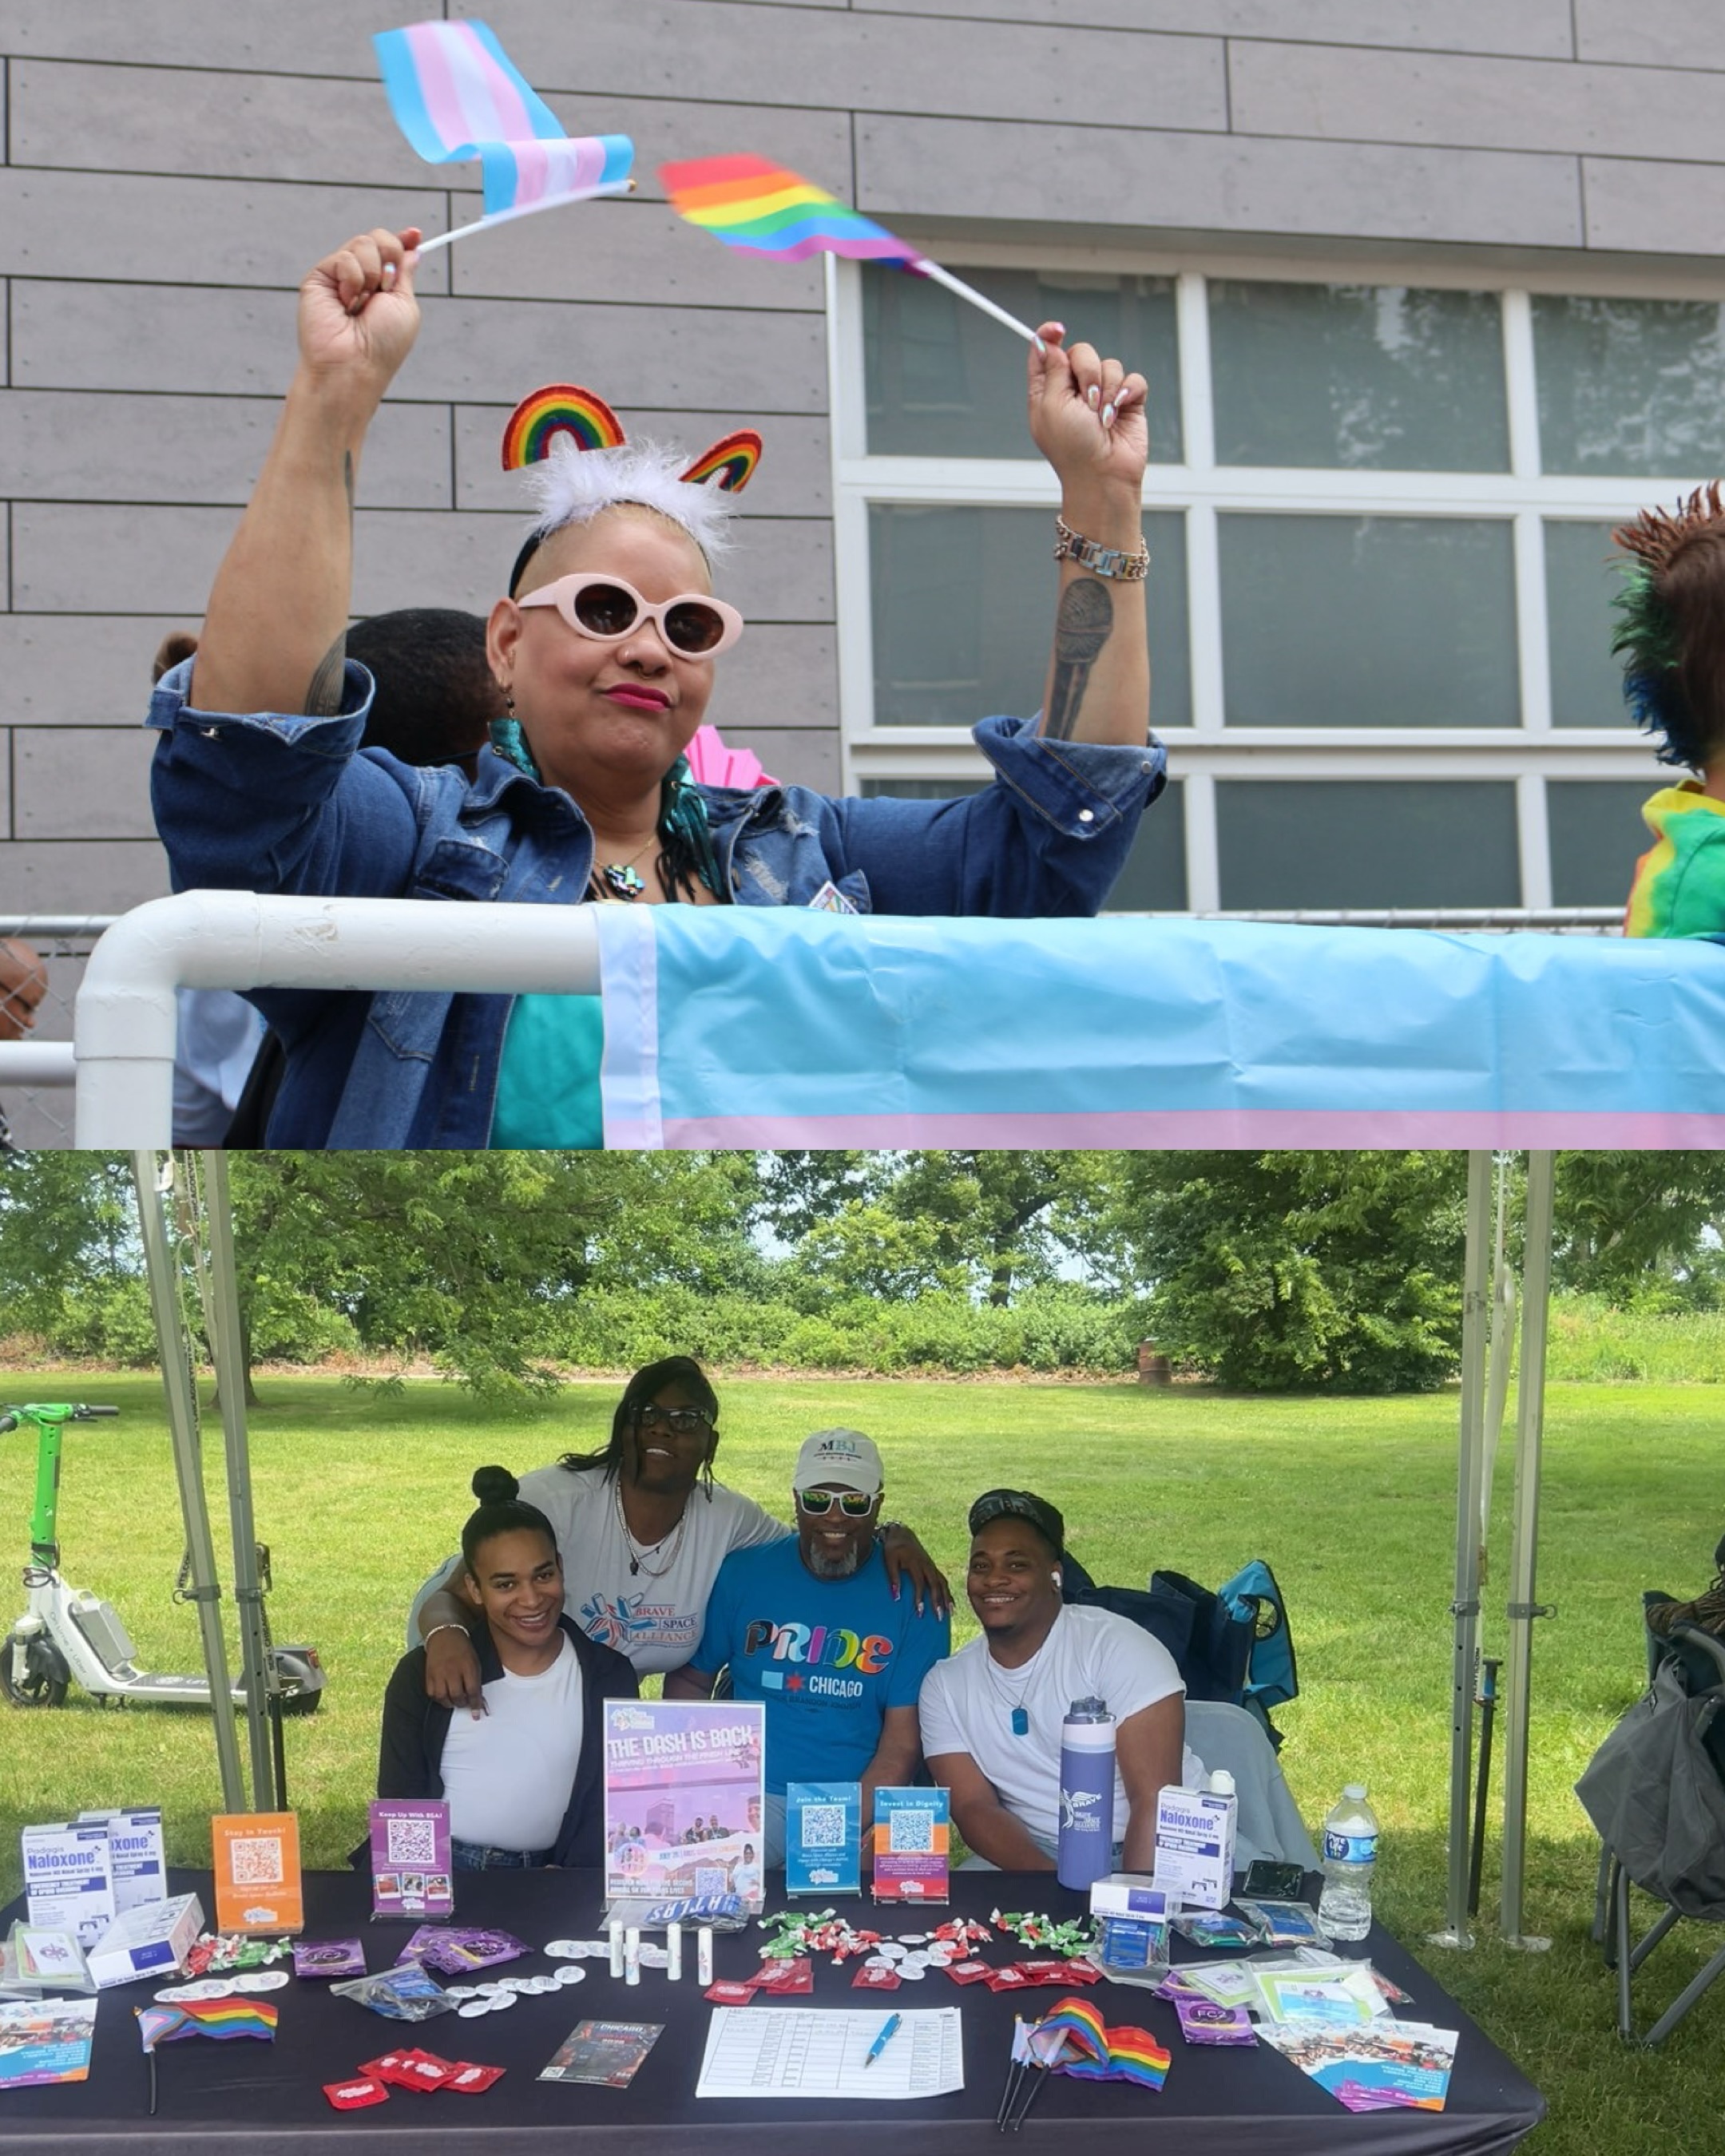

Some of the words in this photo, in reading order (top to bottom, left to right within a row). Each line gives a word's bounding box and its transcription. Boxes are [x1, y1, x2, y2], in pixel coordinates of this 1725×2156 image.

[818, 1440, 855, 1453] MBJ
[636, 1606, 676, 1616] BRAVE
[662, 1618, 697, 1630] SPACE
[634, 1630, 697, 1642] ALLIANCE
[744, 1619, 894, 1674] PRIDE
[809, 1675, 863, 1698] CHICAGO
[609, 1738, 640, 1759] THE
[643, 1732, 687, 1756] DASH
[690, 1730, 707, 1750] IS
[709, 1725, 753, 1749] BACK
[915, 1800, 944, 1809] Dignity
[1160, 1809, 1214, 1831] Naloxone
[28, 1851, 95, 1869] Naloxone
[1197, 2010, 1227, 2019] FC2
[600, 2023, 644, 2033] CHICAGO
